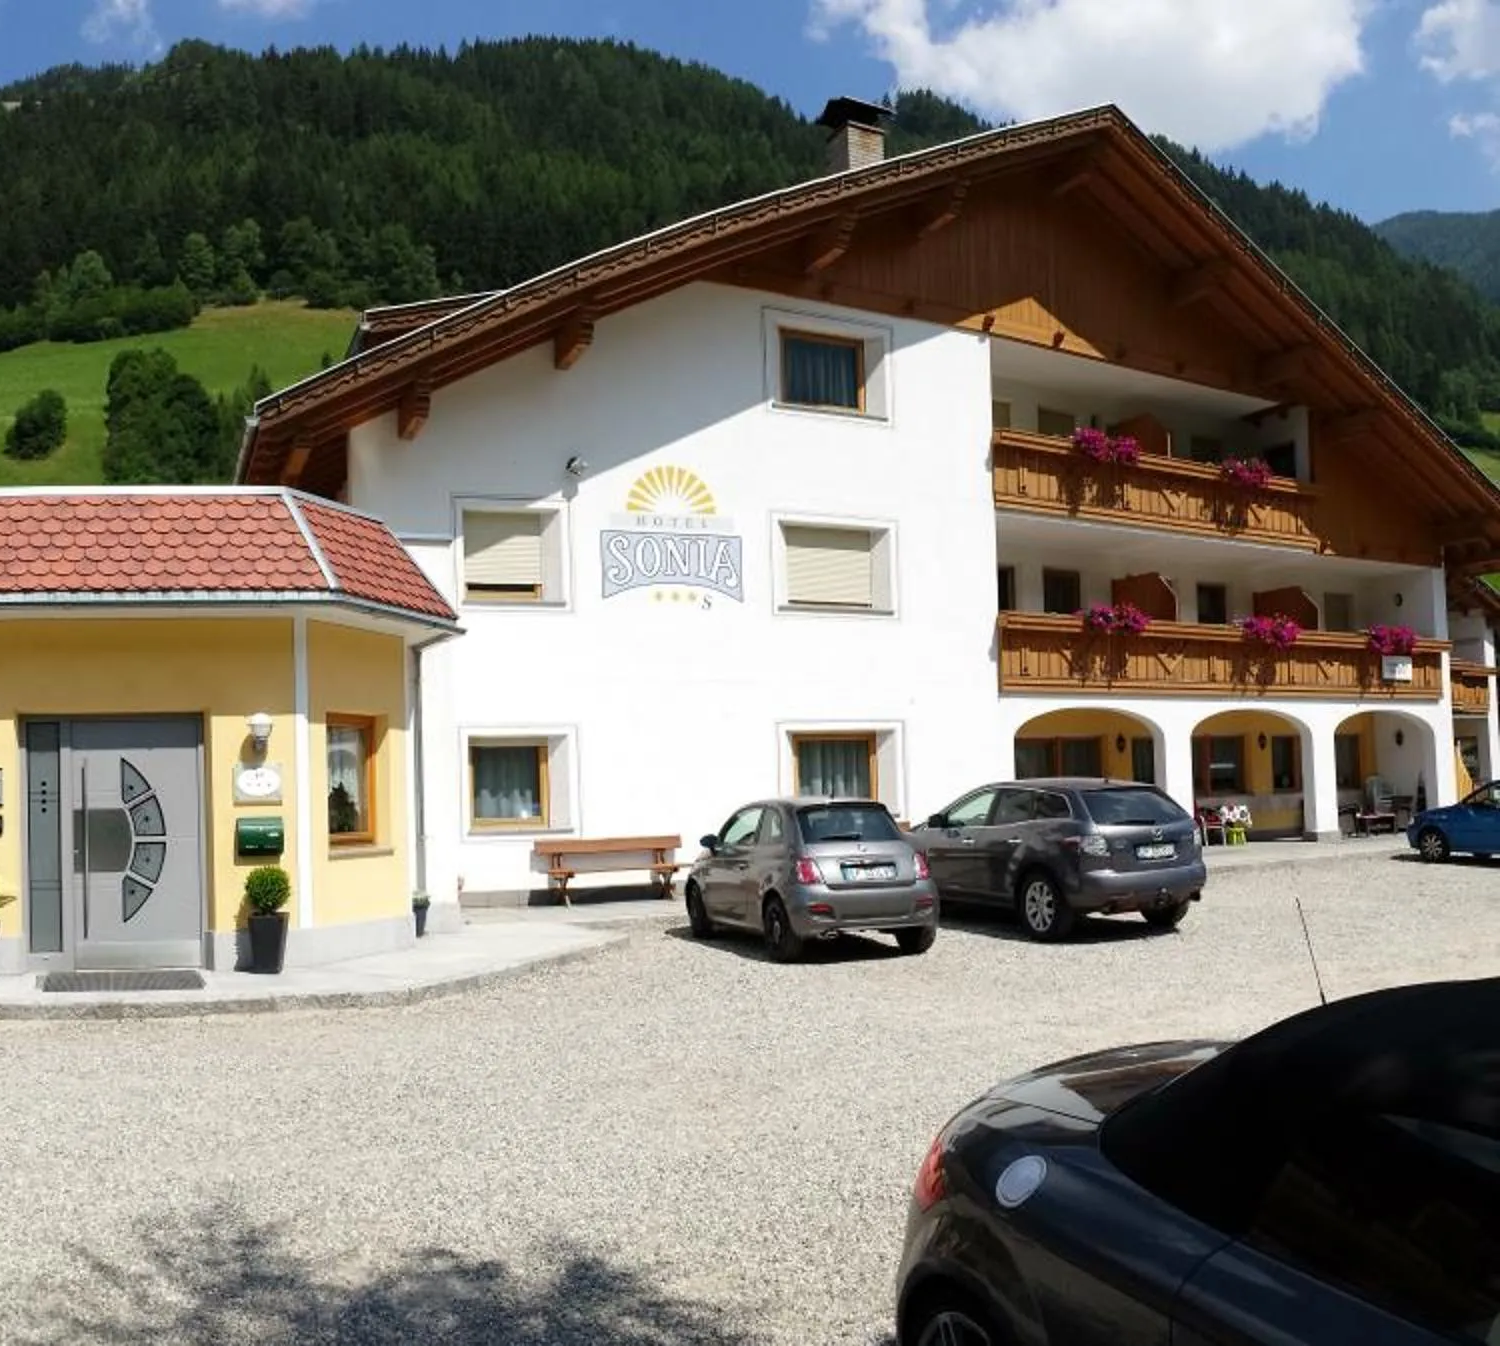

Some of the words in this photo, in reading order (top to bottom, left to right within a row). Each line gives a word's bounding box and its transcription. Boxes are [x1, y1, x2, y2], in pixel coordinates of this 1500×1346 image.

[636, 516, 709, 528] HOTEL
[607, 534, 739, 588] SONIA
[701, 594, 712, 610] S
